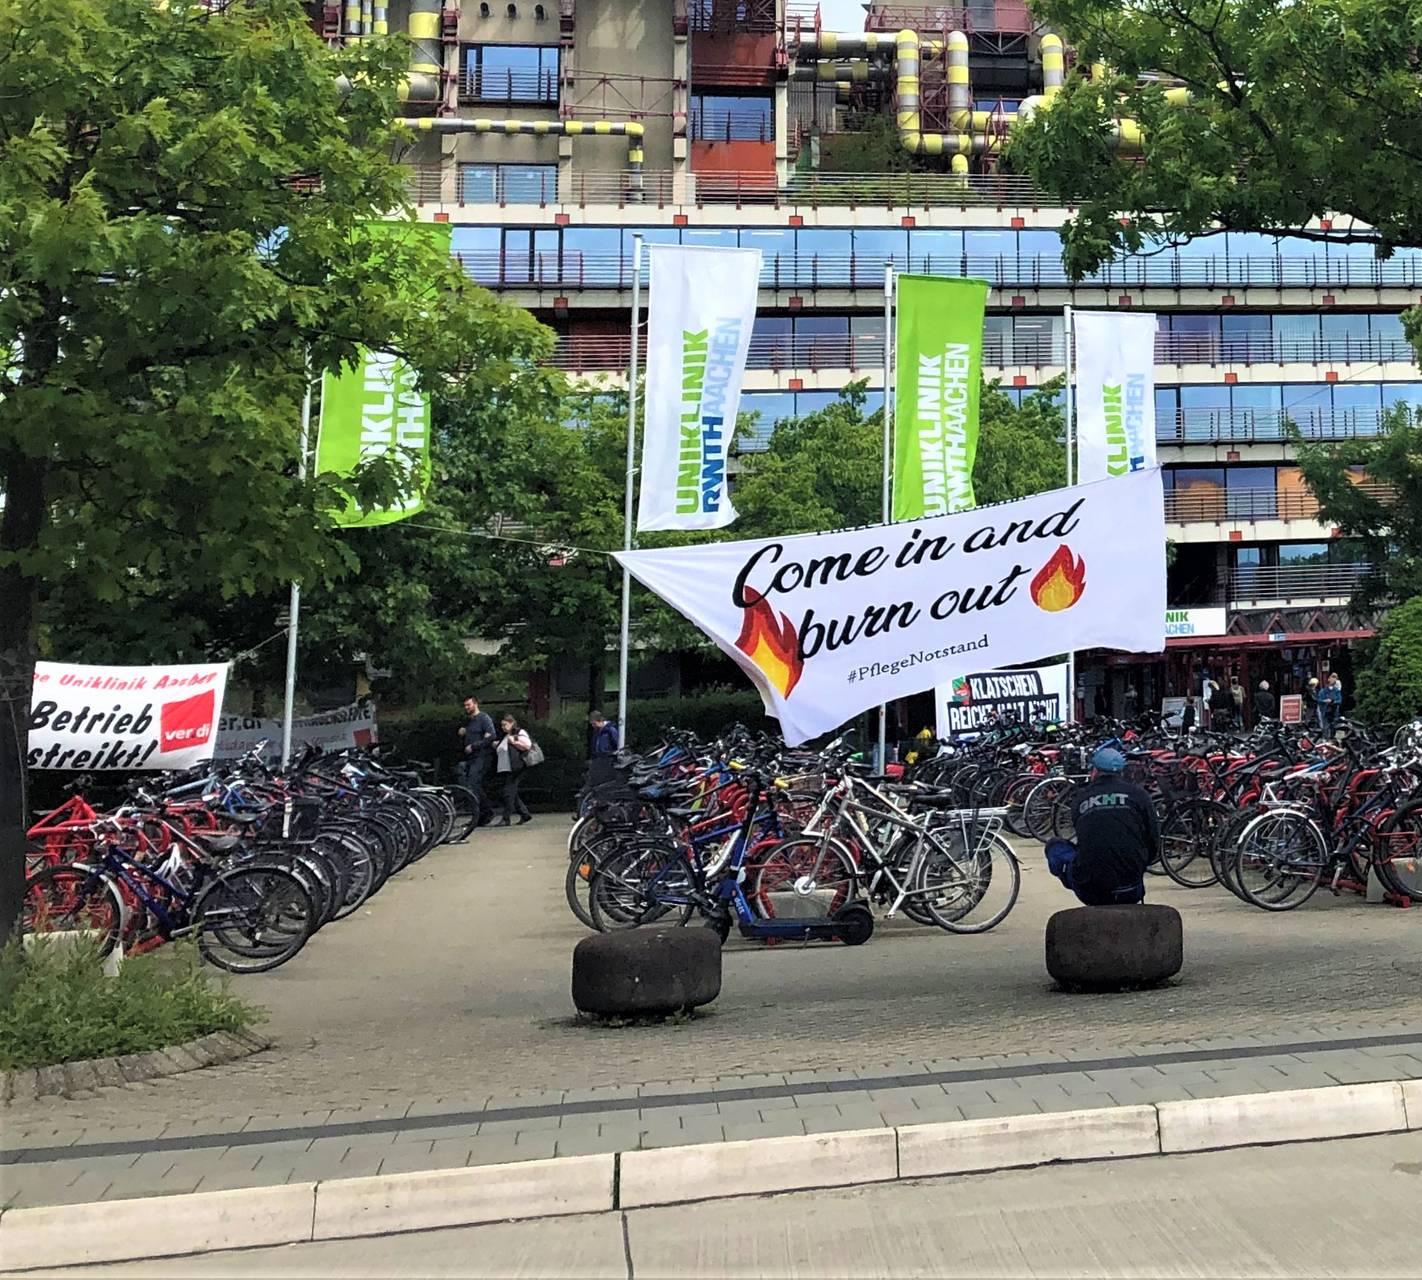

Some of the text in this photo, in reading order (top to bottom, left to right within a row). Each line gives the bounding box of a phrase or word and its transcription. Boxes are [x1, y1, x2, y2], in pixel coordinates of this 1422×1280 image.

[676, 329, 708, 514] UNIKLINIK
[1103, 384, 1128, 476] KLINIK
[732, 498, 1086, 608] Come in and
[797, 565, 1032, 661] burn out
[59, 674, 148, 691] Uniklinik
[847, 634, 989, 684] #PflegeNotstand
[969, 674, 1039, 700] KLATSCHEN
[29, 701, 153, 735] Betrieb
[27, 739, 159, 769] streikt!
